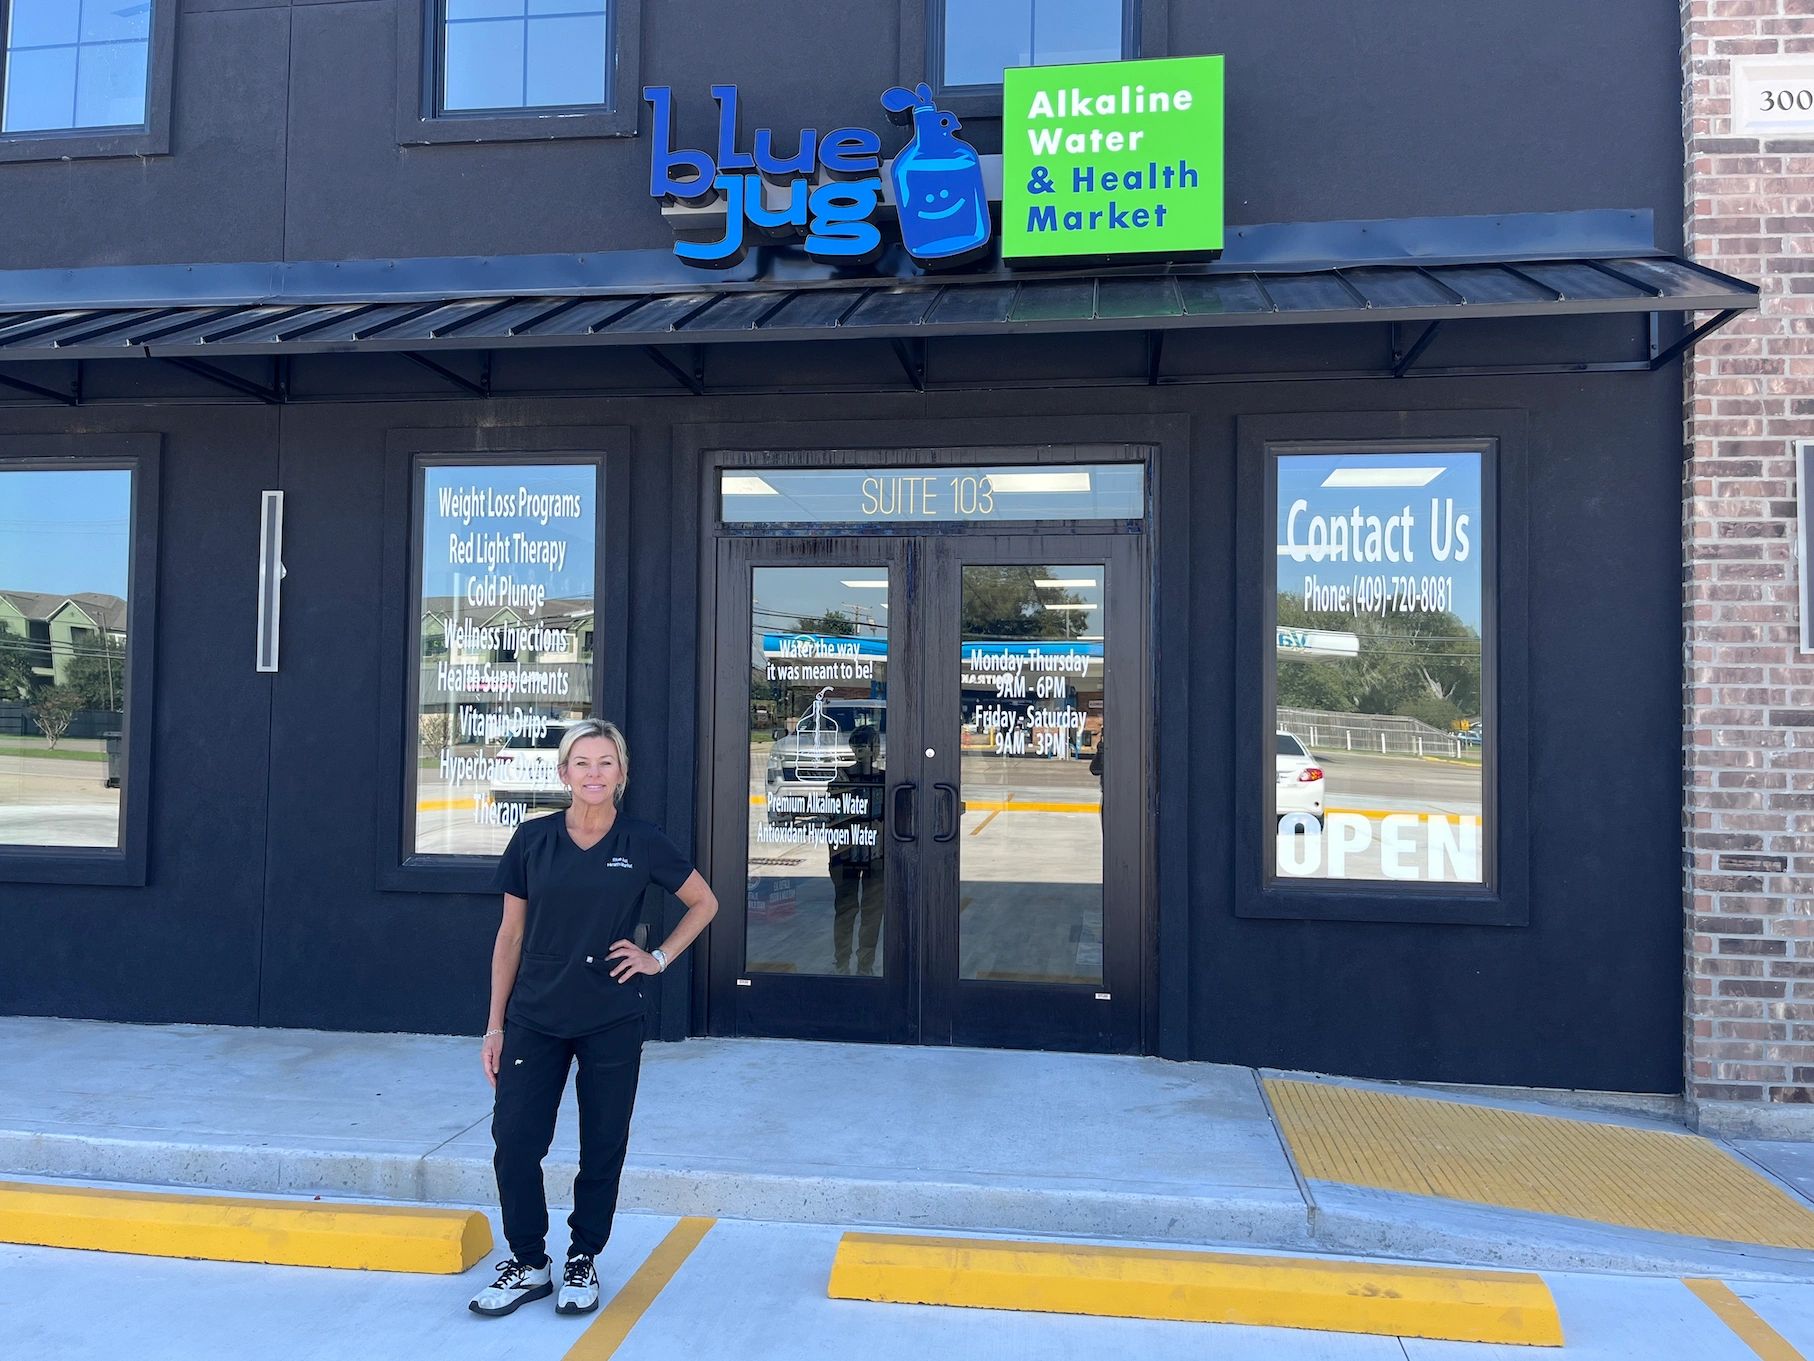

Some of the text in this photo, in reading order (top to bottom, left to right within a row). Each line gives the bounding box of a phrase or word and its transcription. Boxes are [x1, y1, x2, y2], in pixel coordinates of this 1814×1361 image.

[1027, 82, 1193, 120] Alkaline
[1760, 90, 1813, 111] 300
[643, 85, 881, 198] blue
[1027, 126, 1144, 156] Water
[1026, 160, 1199, 194] & Health
[673, 175, 882, 261] jug
[1026, 201, 1168, 233] Market
[439, 486, 581, 526] Weight Loss Programs
[861, 477, 994, 515] SUITE 103
[1286, 498, 1470, 562] Contact Us
[449, 532, 567, 572] Red Light Therapy
[467, 575, 545, 615] Cold Plunge
[1304, 574, 1453, 618] Phone: (409)-720-8081
[444, 617, 568, 660] Wellness Injections
[779, 638, 860, 662] Water the way
[437, 661, 569, 701] Health Supplements
[767, 660, 873, 680] it was meant to be!
[996, 676, 1026, 698] 9AM
[1037, 676, 1066, 699] 6PM
[460, 705, 548, 746] Vitamin Drips
[975, 704, 1016, 734] Friday
[1027, 704, 1087, 735] Saturday
[995, 732, 1026, 755] 9AM
[1036, 732, 1066, 756] 3PM
[473, 792, 528, 833] Therapy
[767, 791, 868, 815] Premium Alkaline Water
[756, 821, 878, 850] Antioxidant Hydrogen Water
[1278, 812, 1477, 881] OPEN
